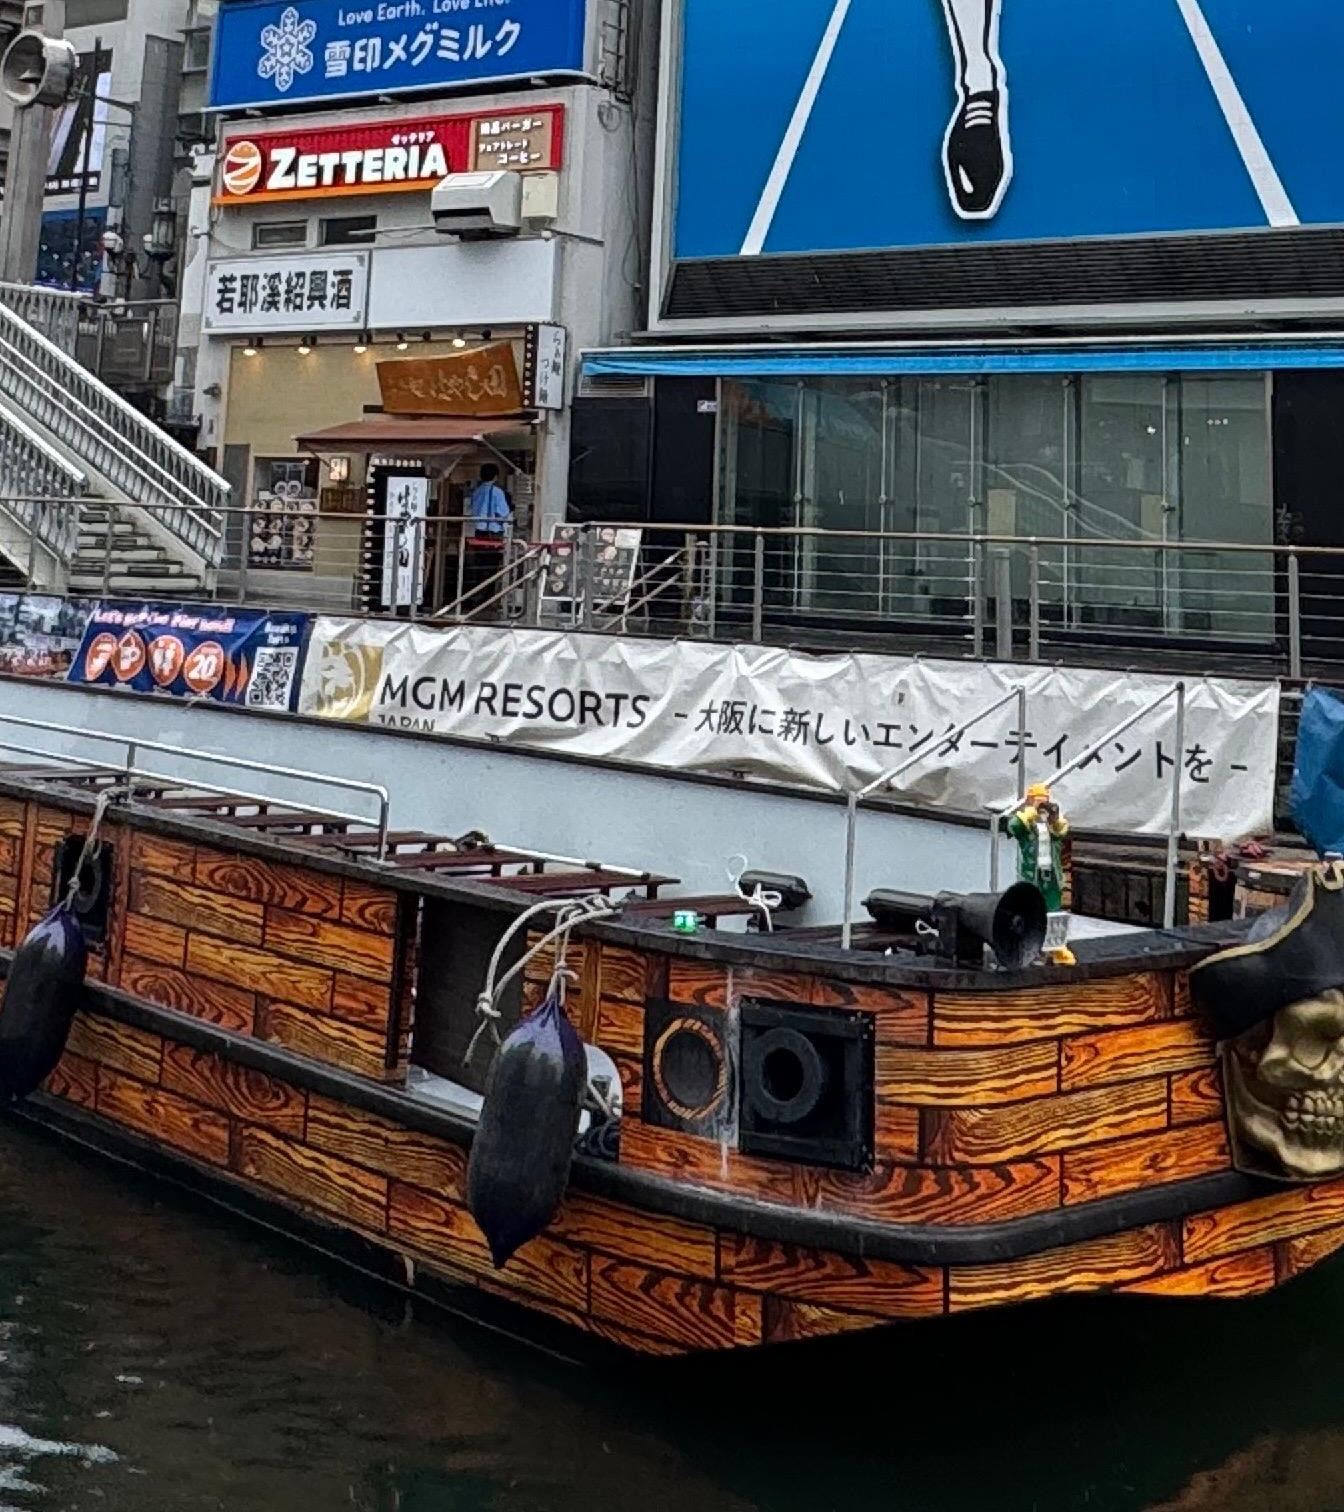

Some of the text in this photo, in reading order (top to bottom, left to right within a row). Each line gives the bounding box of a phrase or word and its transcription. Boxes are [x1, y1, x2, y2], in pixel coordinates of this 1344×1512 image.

[338, 6, 375, 27] Love
[324, 18, 522, 79] 雪印メグミルク
[266, 141, 449, 190] ZETTERIA
[496, 150, 543, 165] コーヒー
[379, 672, 651, 729] MGM RESORTS
